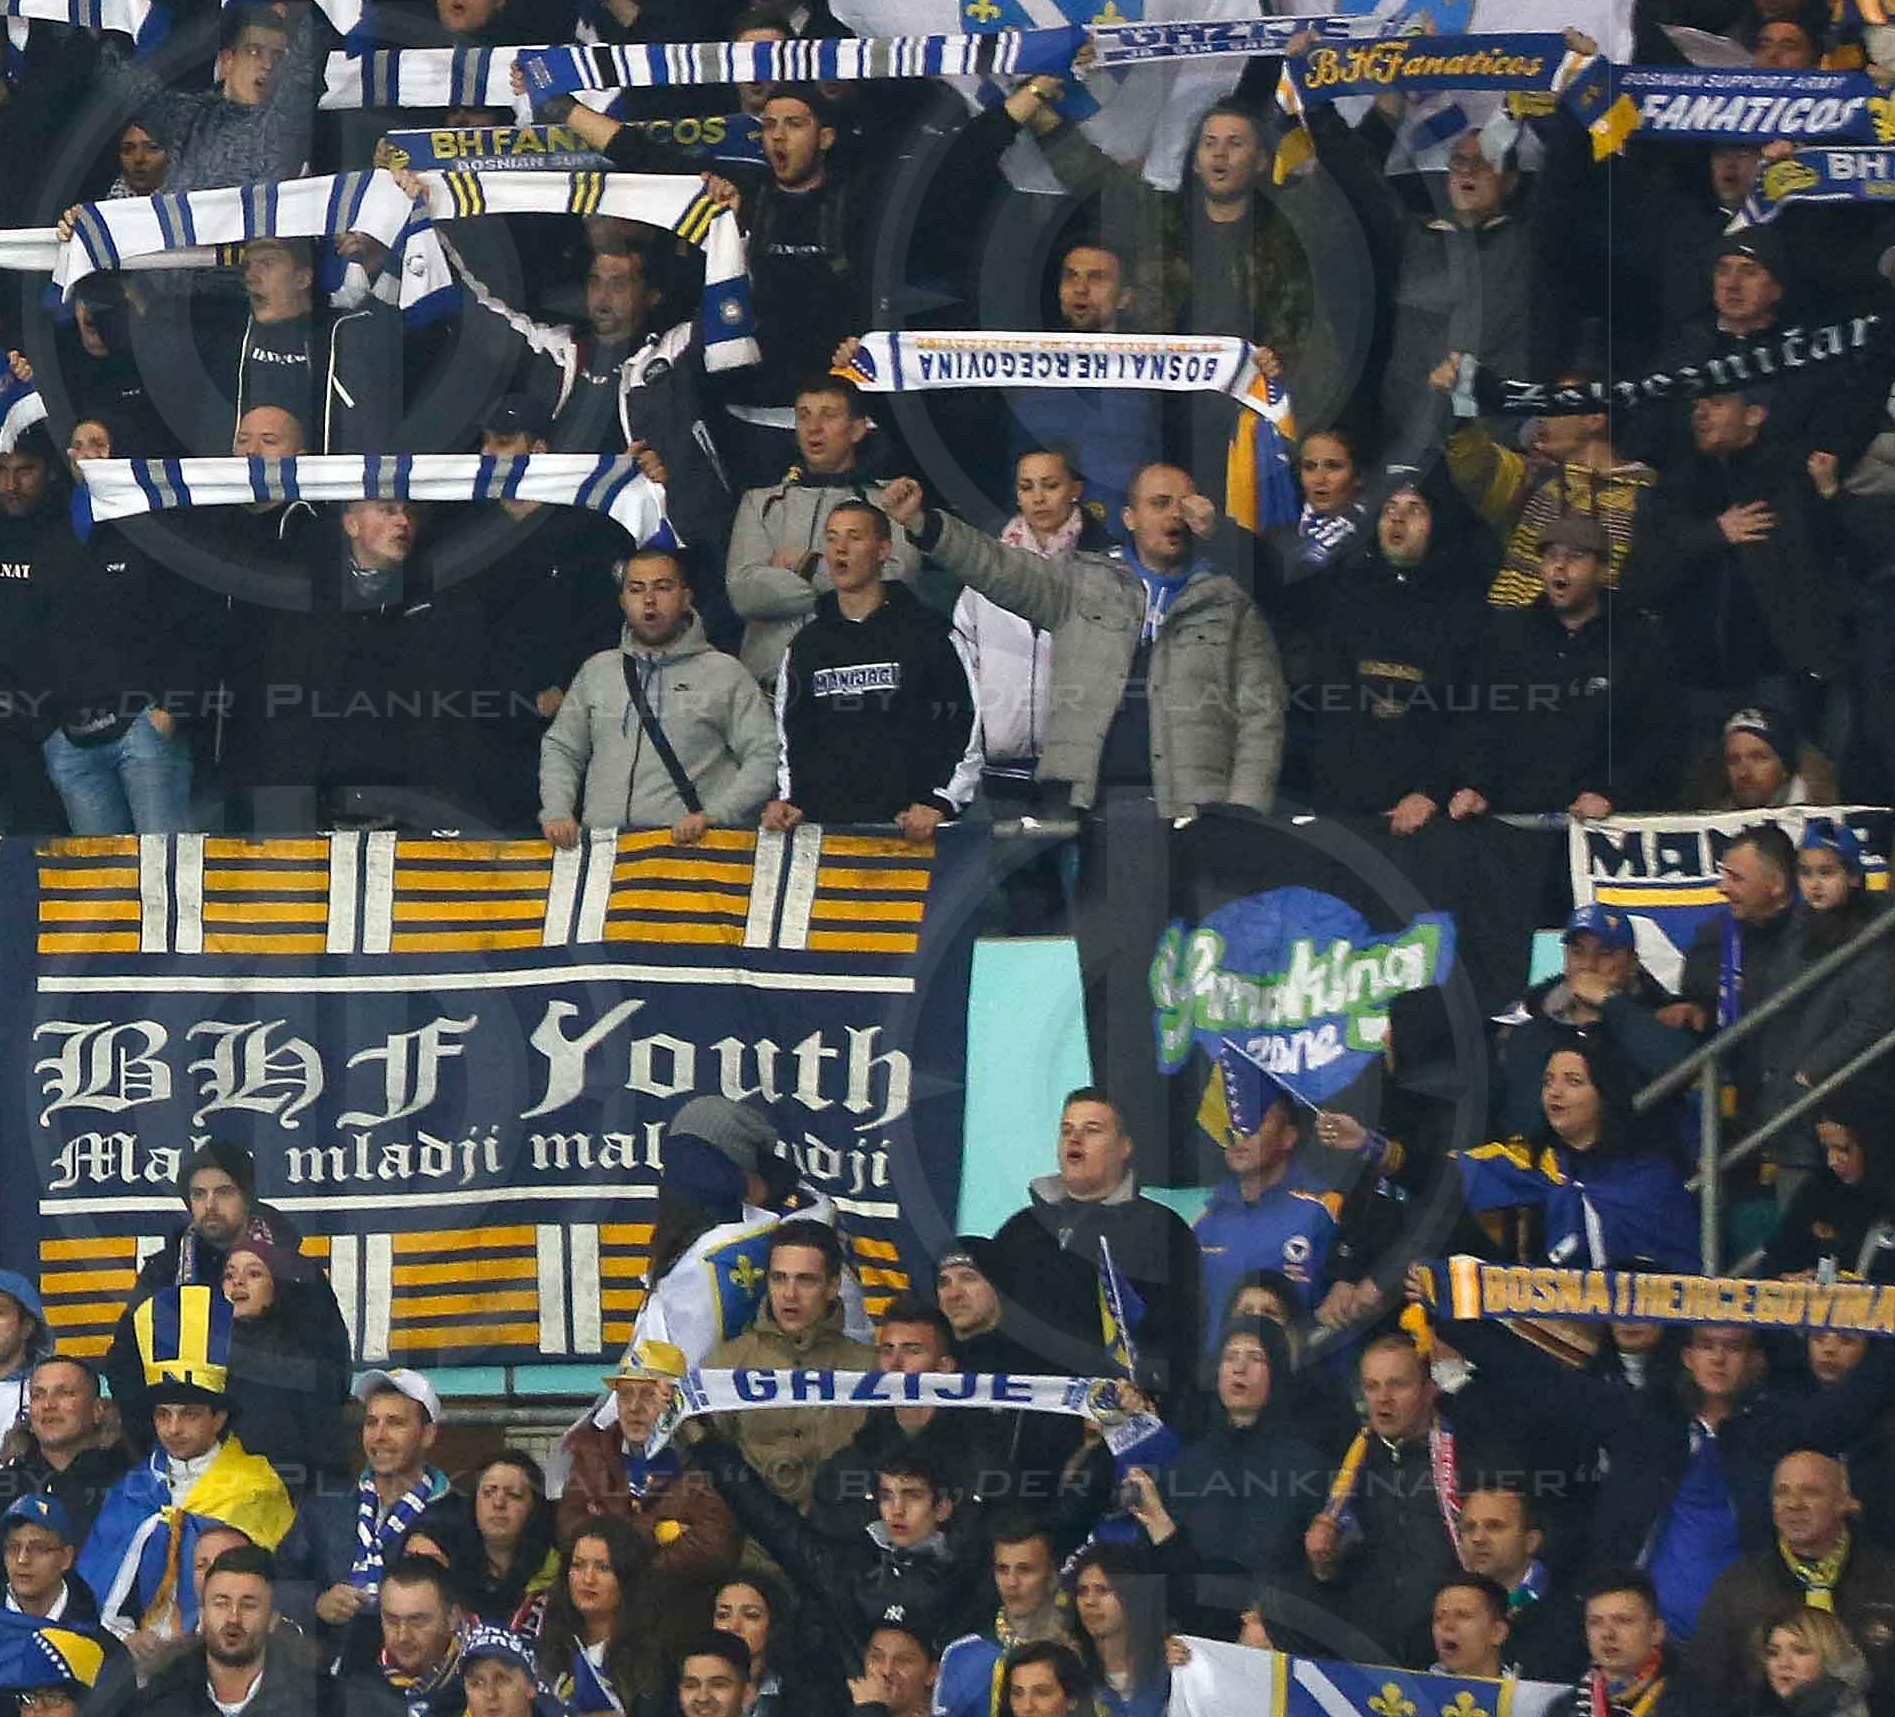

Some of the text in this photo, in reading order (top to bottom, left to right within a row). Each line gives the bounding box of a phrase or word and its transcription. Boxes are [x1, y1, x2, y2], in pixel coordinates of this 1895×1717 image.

[1641, 92, 1867, 133] FANATICOS
[431, 129, 485, 159] BH
[1826, 151, 1888, 180] BH
[919, 352, 1109, 380] HERCEGOVINA
[1135, 353, 1219, 382] BOSNA
[519, 998, 913, 1130] Youth
